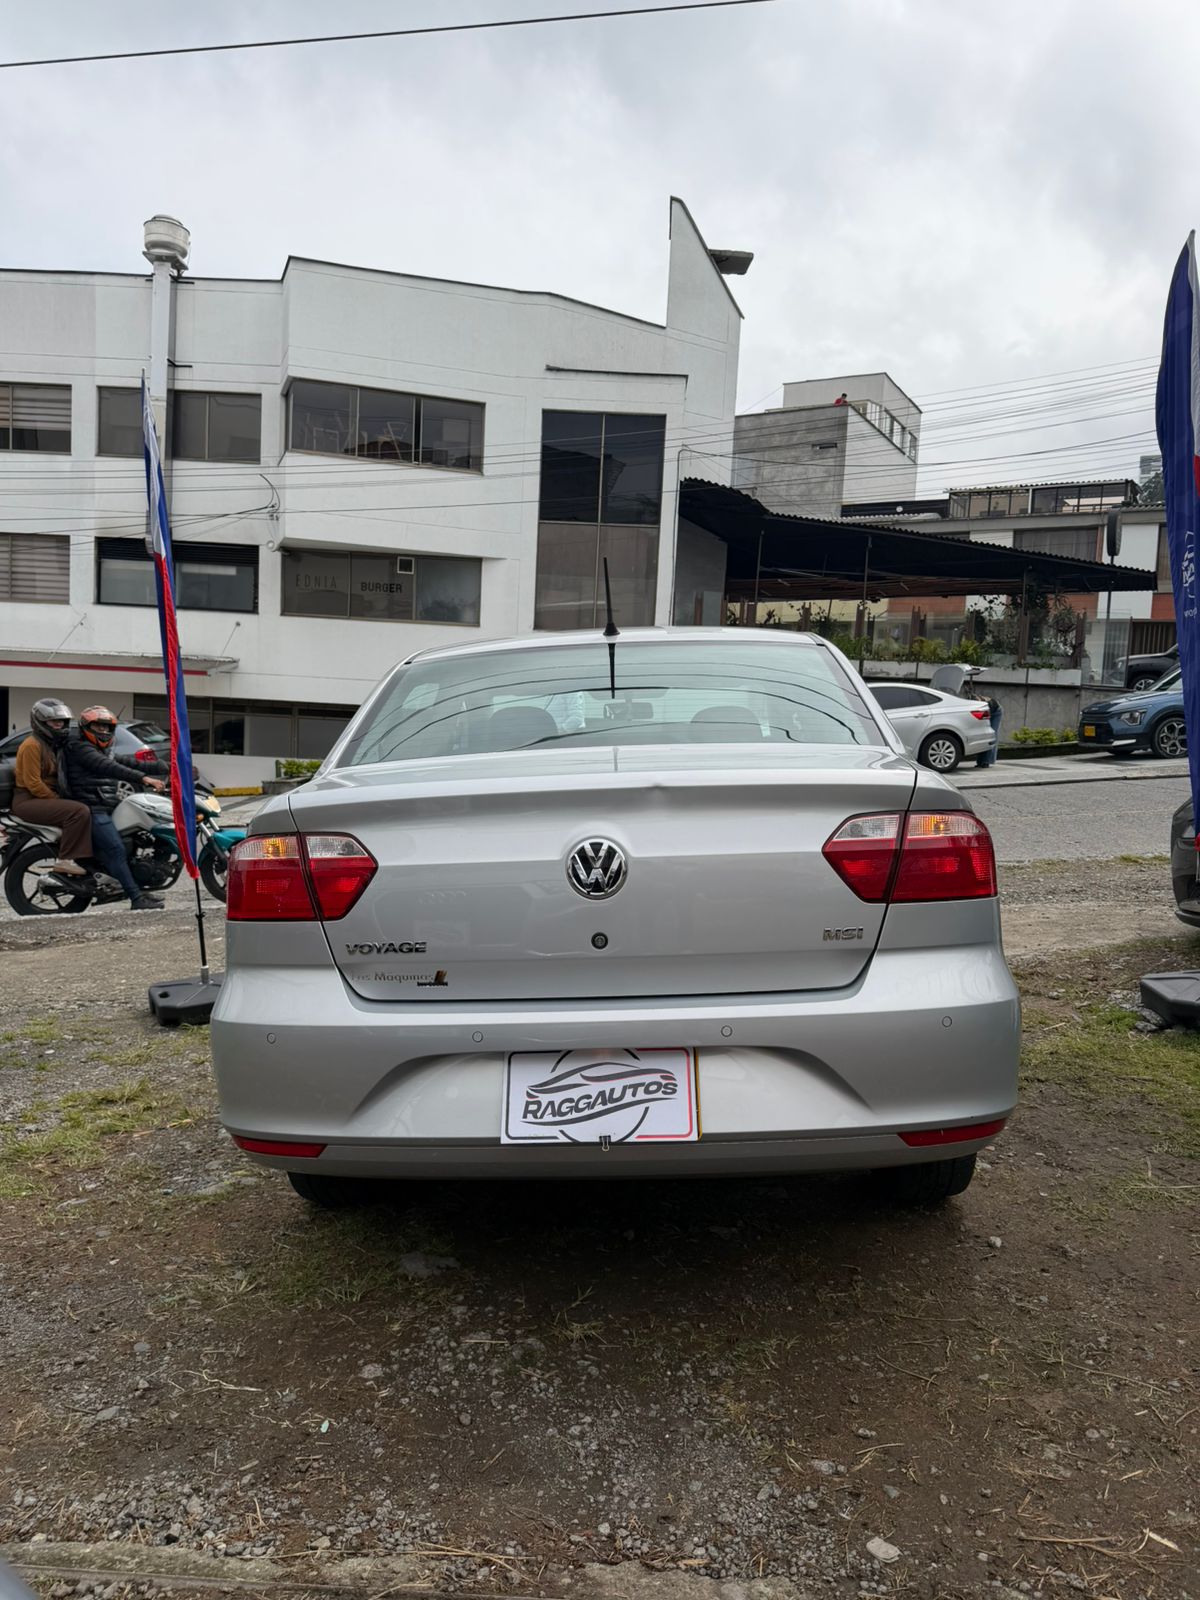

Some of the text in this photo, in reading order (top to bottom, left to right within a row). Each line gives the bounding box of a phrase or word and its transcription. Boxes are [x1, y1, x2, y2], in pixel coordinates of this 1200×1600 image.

[360, 581, 403, 594] BURGER
[345, 941, 427, 955] VOYAGE
[522, 1081, 678, 1120] RAGGAUTOS
